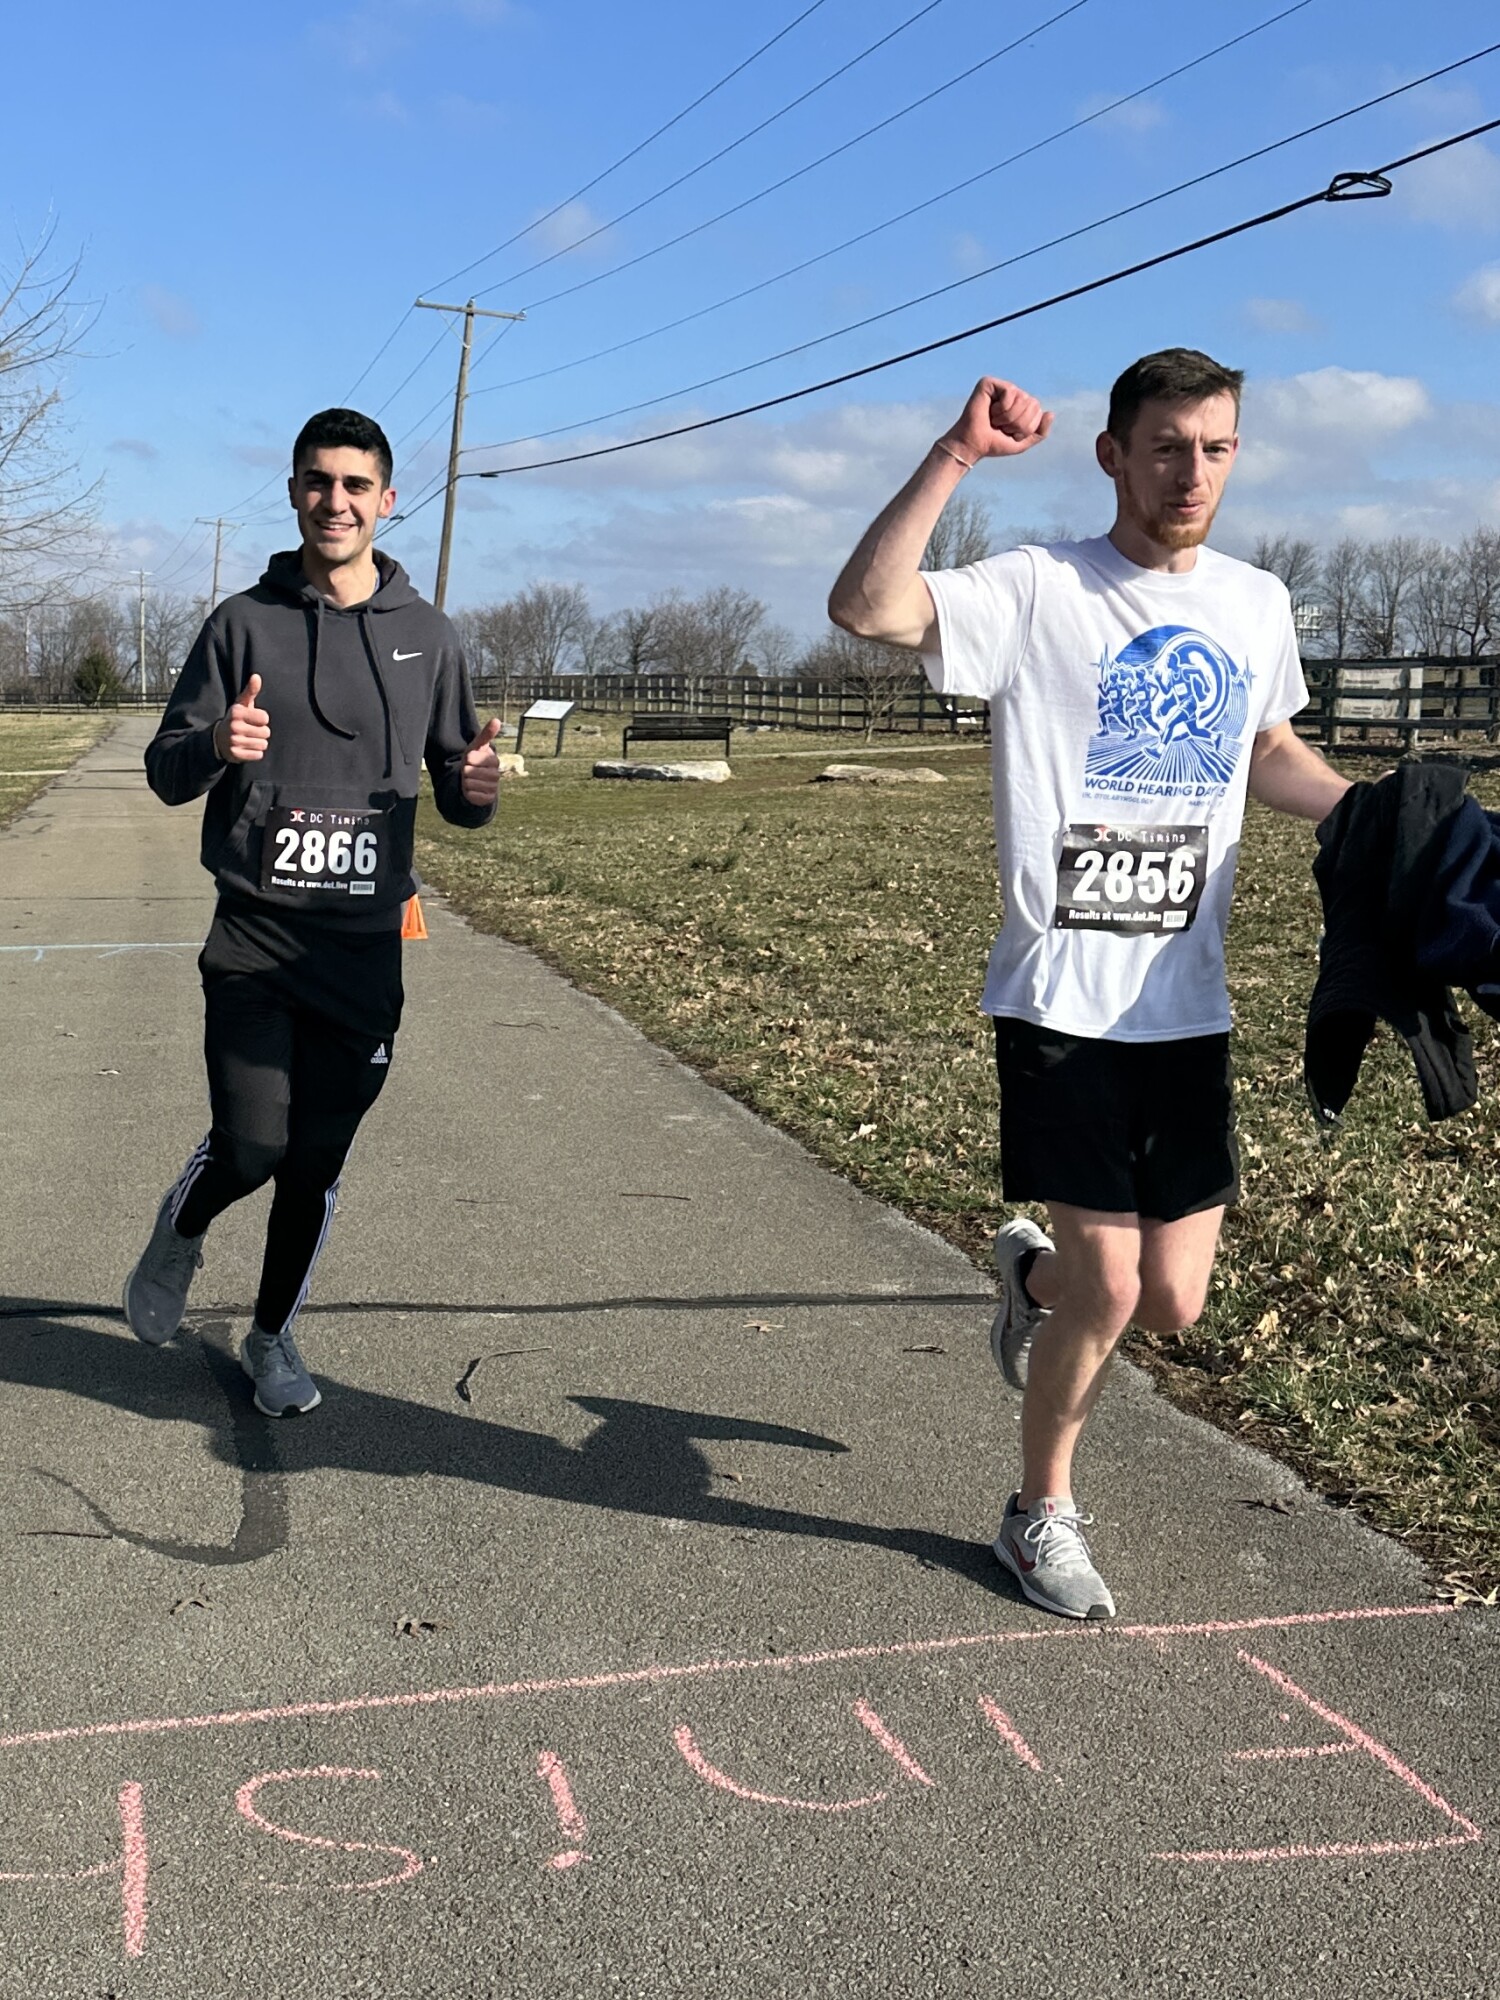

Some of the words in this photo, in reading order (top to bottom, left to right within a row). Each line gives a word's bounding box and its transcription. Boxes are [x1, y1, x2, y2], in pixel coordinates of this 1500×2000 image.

[1085, 777, 1135, 792] WORLD
[310, 813, 324, 824] DC
[330, 814, 370, 826] Timing
[1117, 830, 1132, 842] DC
[1140, 831, 1186, 843] Timing
[274, 828, 377, 875] 2866
[271, 876, 296, 887] Results
[297, 880, 305, 889] at
[1072, 850, 1196, 904] 2856
[1069, 909, 1100, 921] Results
[1102, 911, 1112, 921] at
